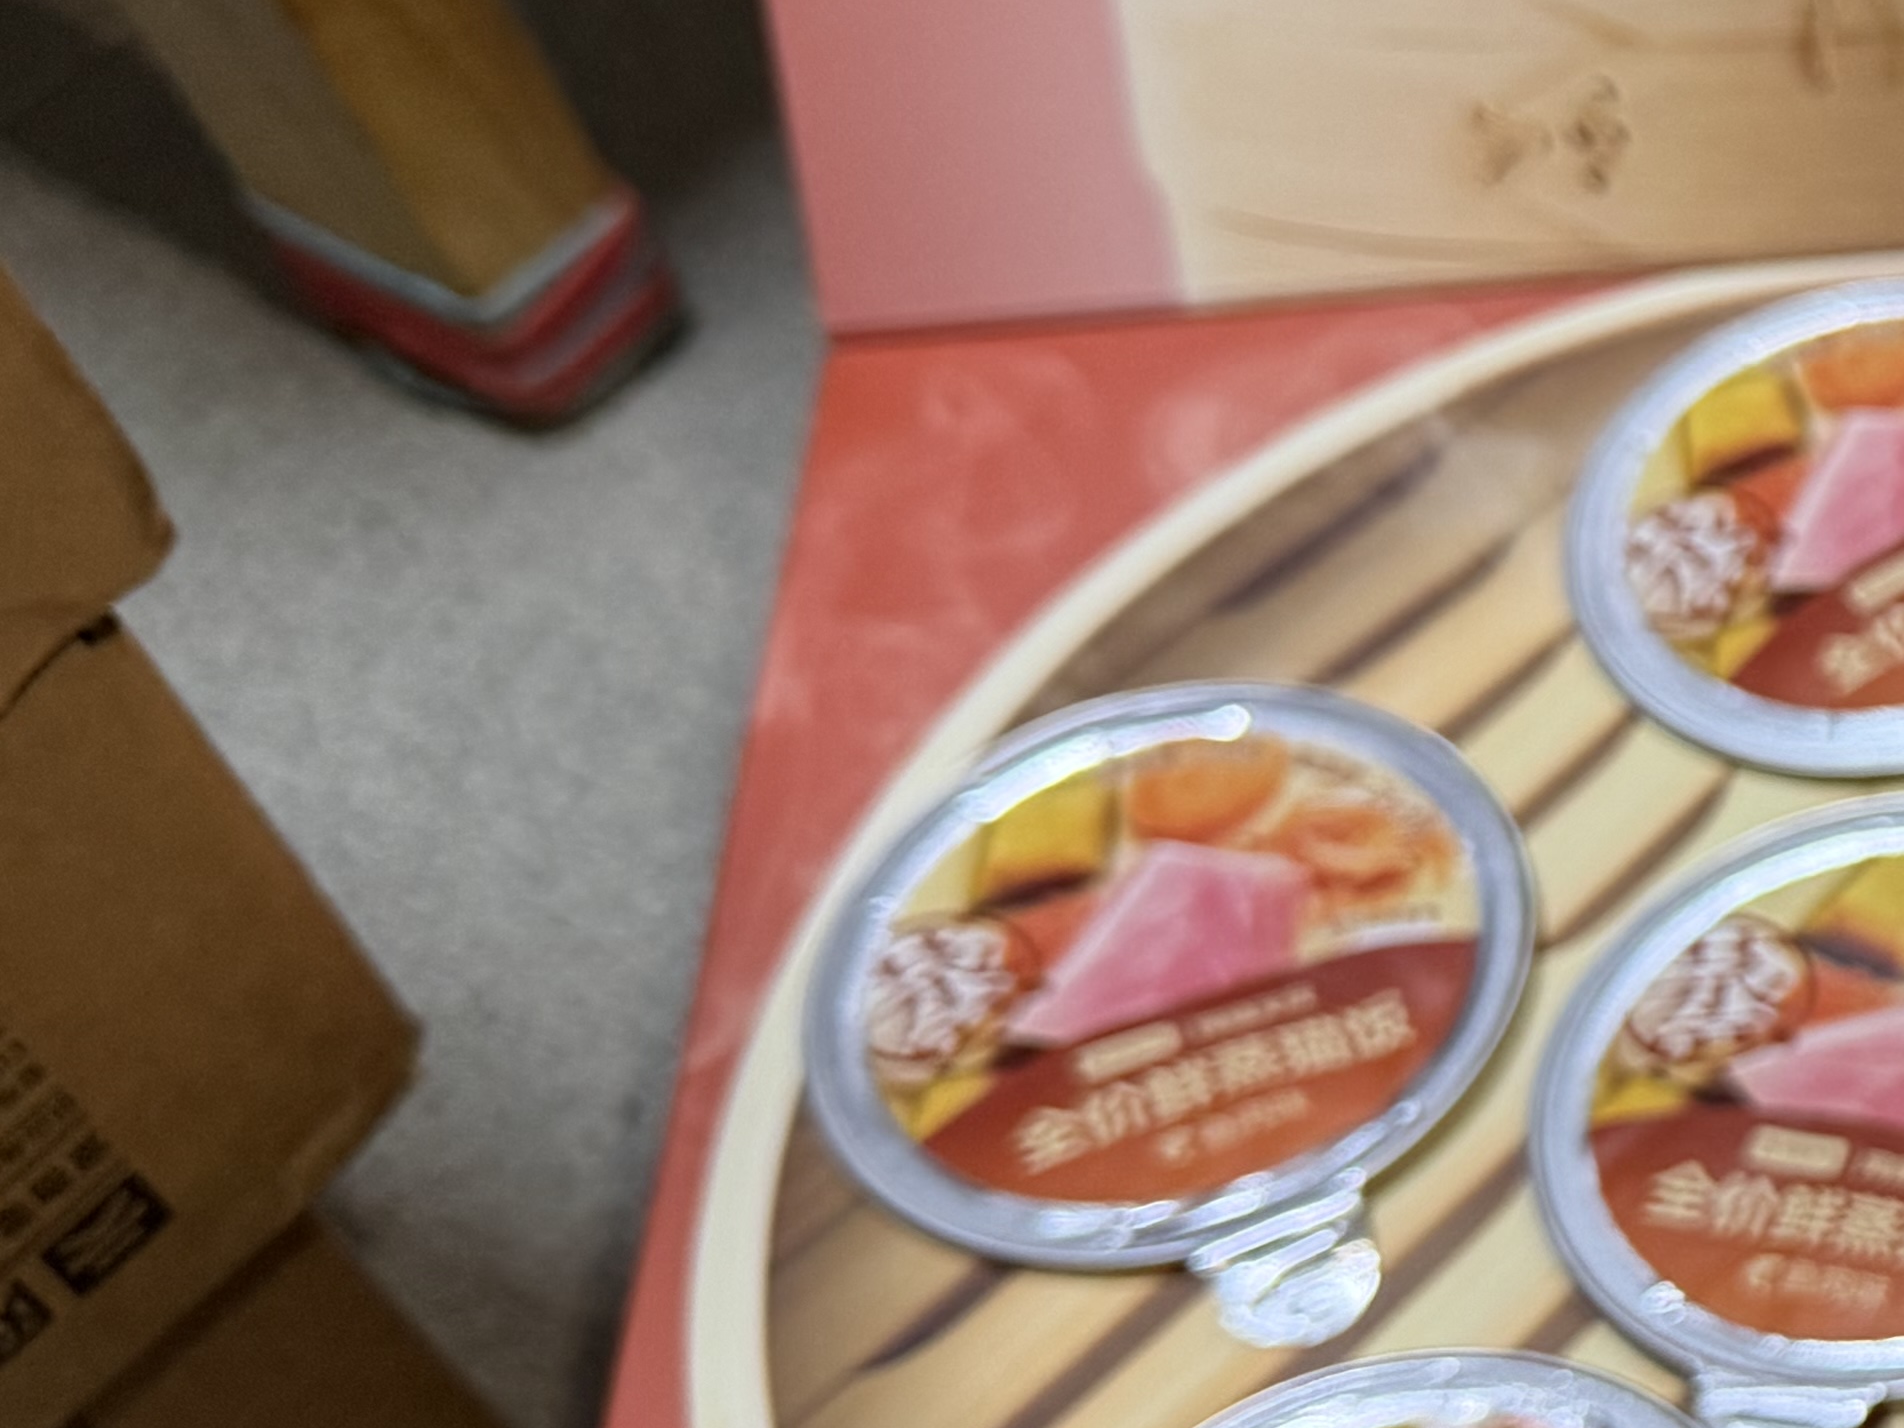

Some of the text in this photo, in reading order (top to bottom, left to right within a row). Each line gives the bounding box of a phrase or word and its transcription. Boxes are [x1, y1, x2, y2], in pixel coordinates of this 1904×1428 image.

[1015, 988, 1416, 1175] 全价鲜蒸猫饭
